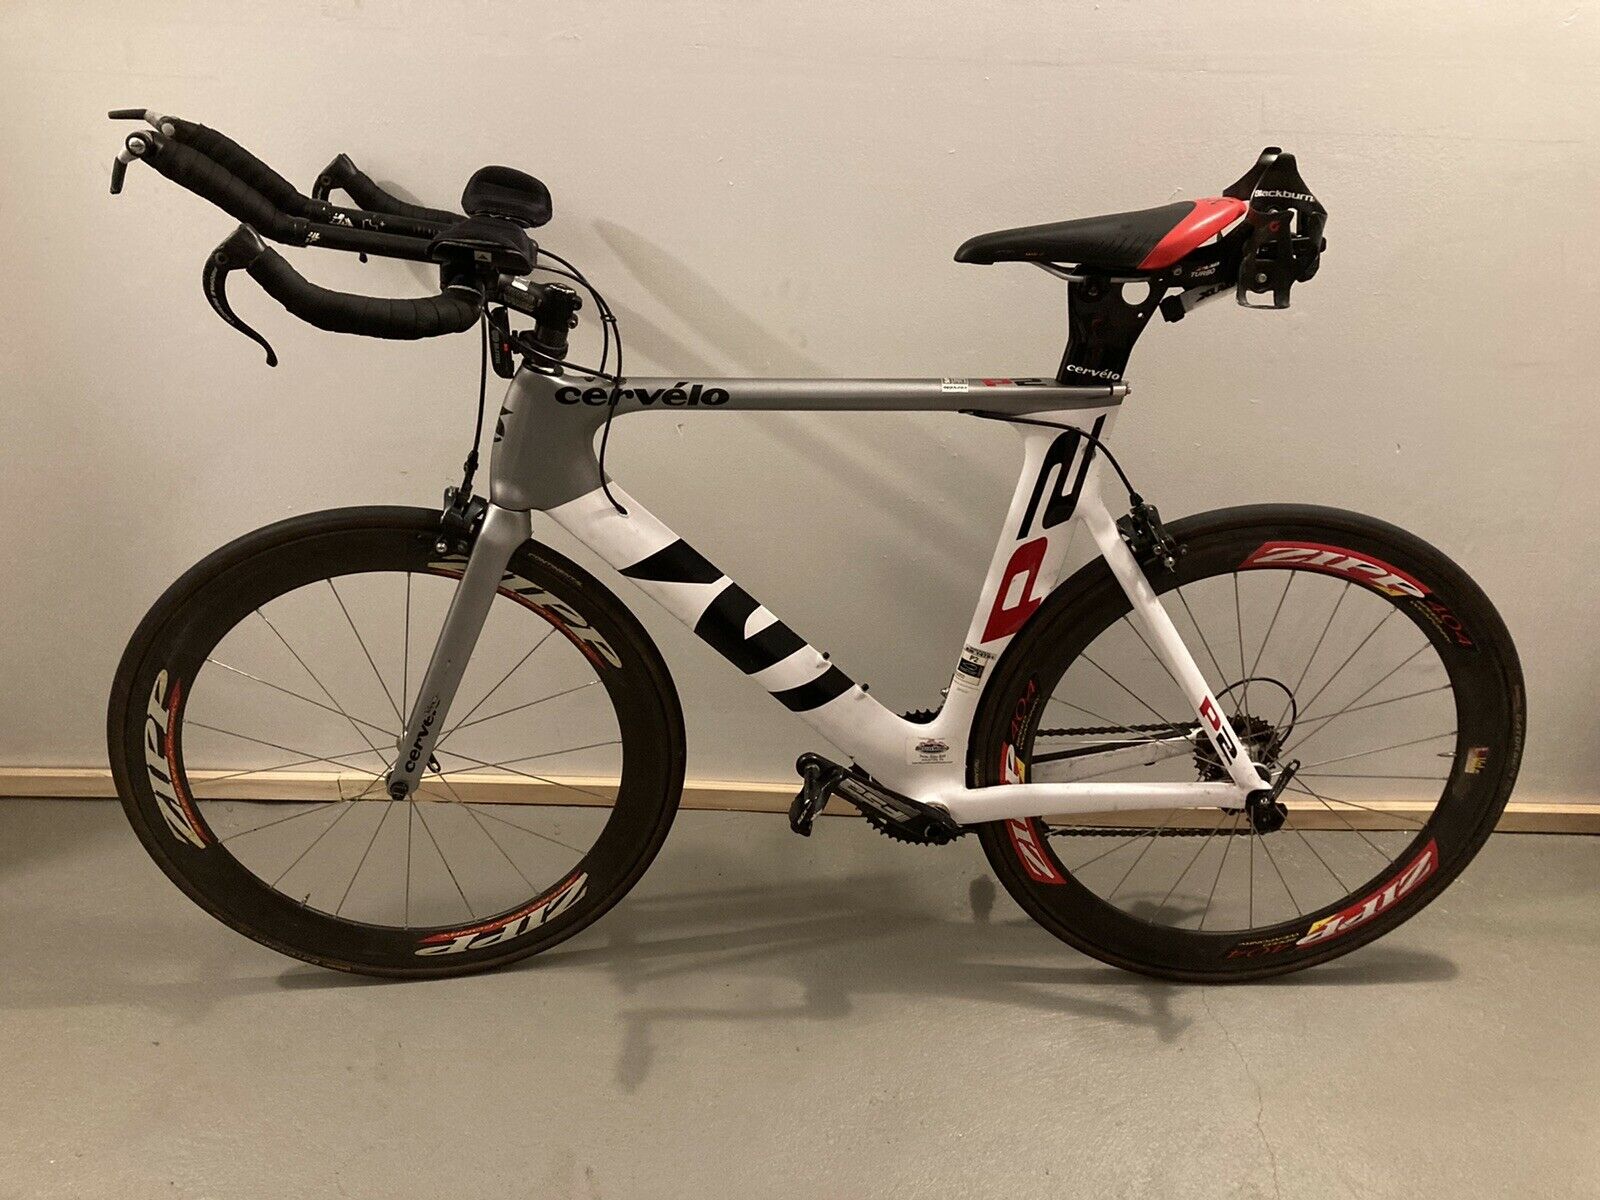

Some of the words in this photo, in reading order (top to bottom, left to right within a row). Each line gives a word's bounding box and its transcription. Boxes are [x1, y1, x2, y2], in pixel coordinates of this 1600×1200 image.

[1254, 189, 1315, 203] Blackburn
[554, 381, 730, 406] cervélo
[1065, 363, 1121, 381] cervélo
[1253, 547, 1426, 599] ZIPP
[144, 668, 207, 850] ZIPP
[404, 695, 441, 773] cervé
[1004, 743, 1056, 880] ZIP
[413, 871, 589, 957] ZIPP
[1295, 850, 1433, 946] ZIPP
